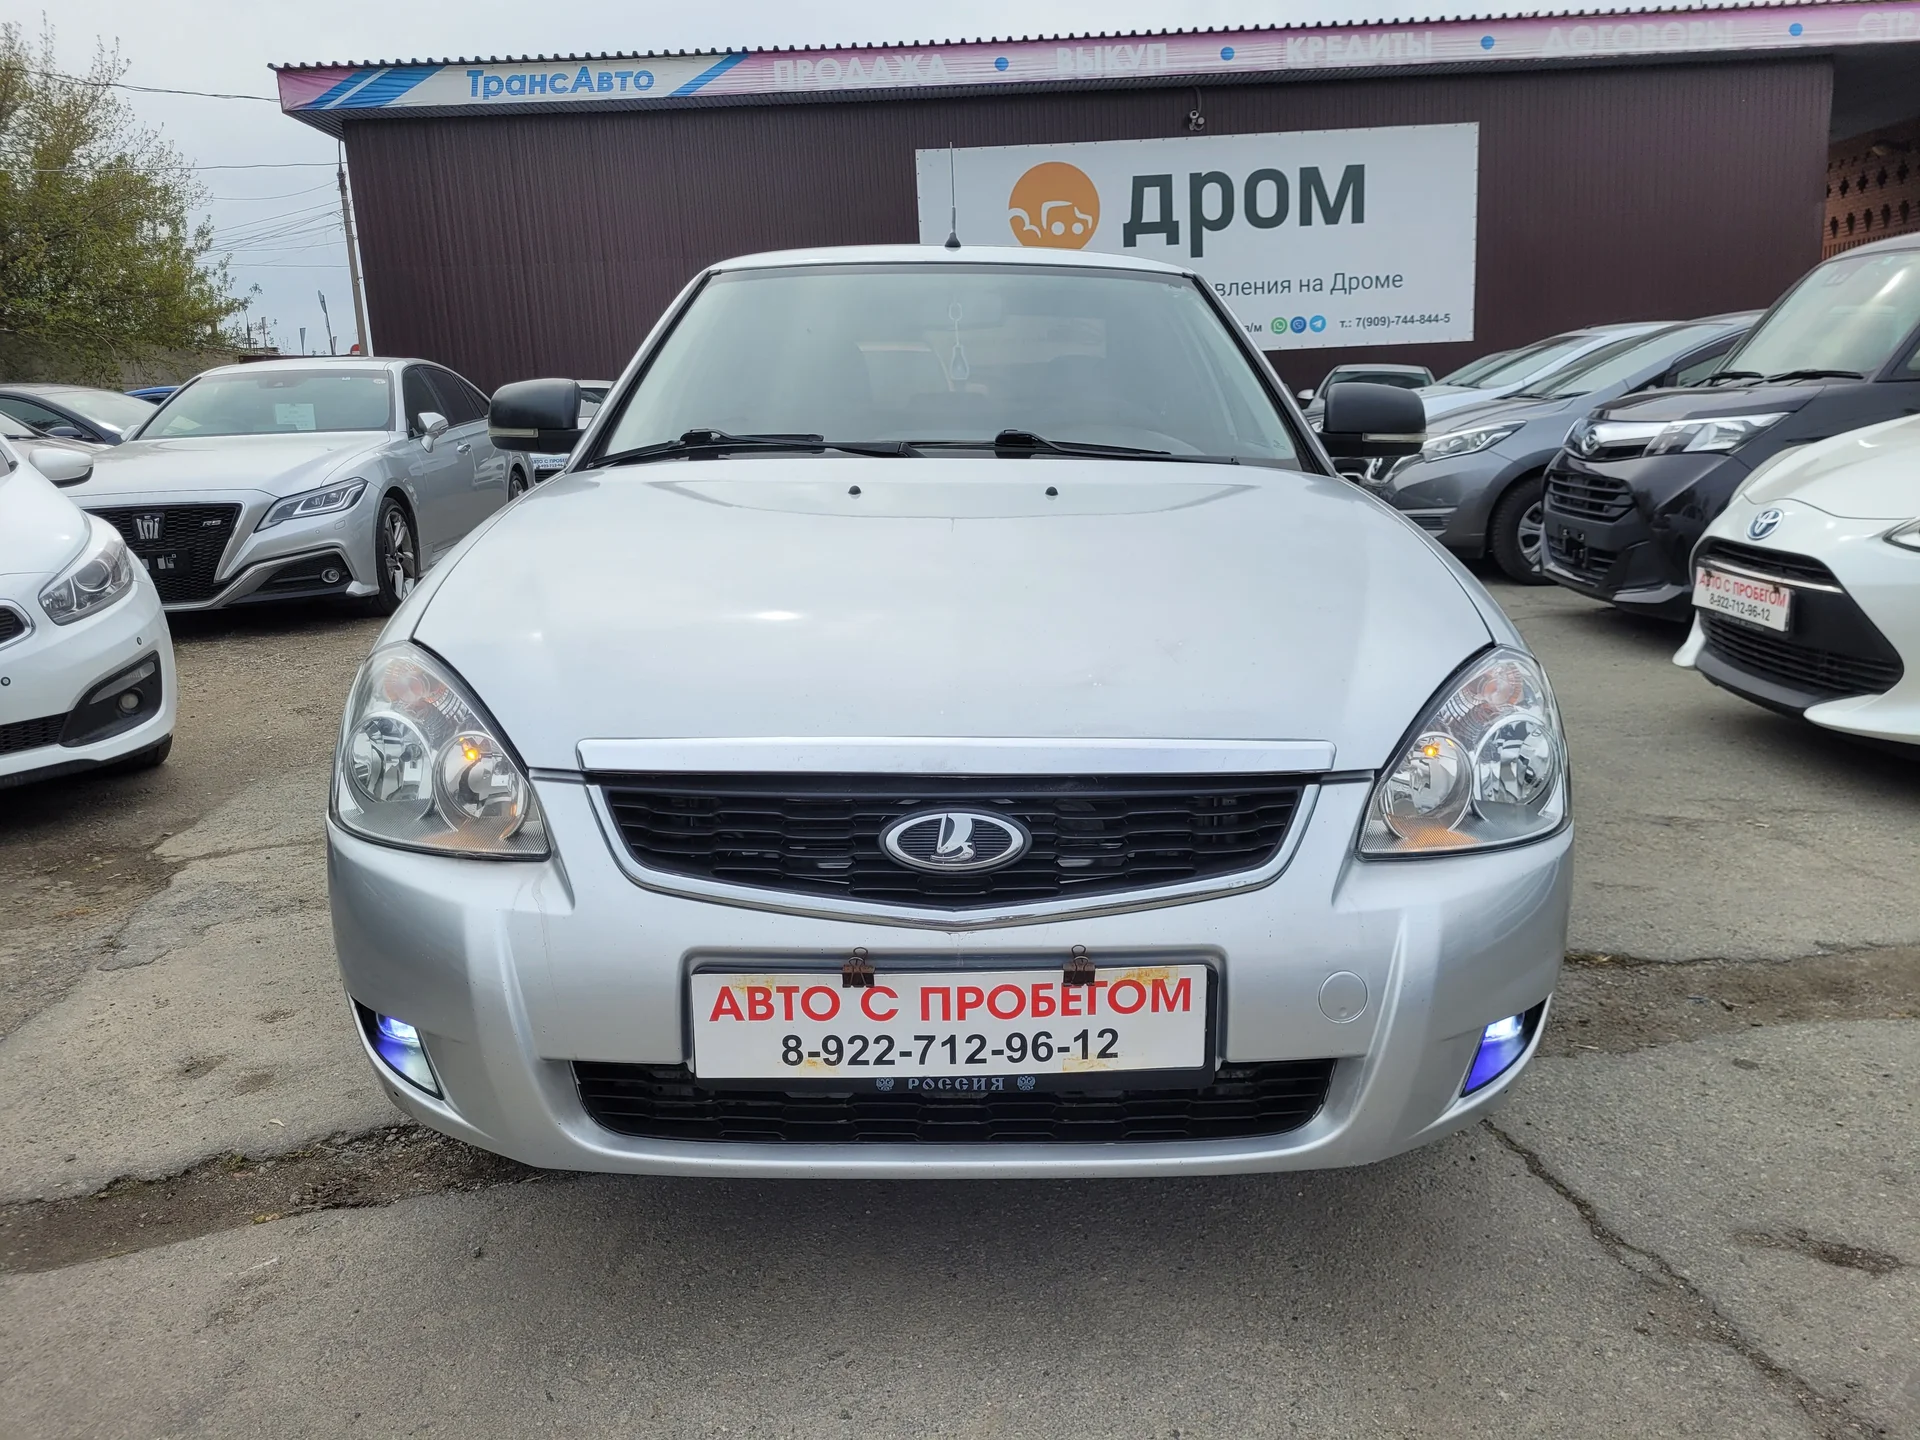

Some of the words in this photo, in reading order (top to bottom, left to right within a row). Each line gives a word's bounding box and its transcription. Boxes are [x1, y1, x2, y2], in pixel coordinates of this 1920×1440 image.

[1858, 11, 1920, 38] СТР
[1056, 43, 1167, 75] ВЫКУП
[1286, 31, 1433, 62] КРЕДИТЫ
[466, 66, 655, 100] ТрансАвто
[773, 54, 949, 88] ПРОДАЖА
[1300, 277, 1323, 293] на
[1330, 272, 1404, 295] Дроме
[1355, 313, 1451, 329] 7(909)-744-844-5
[202, 519, 222, 527] RS
[1709, 593, 1771, 622] 8-922-712-96-12
[1723, 579, 1731, 592] С
[1733, 582, 1786, 607] ПРОБЕГОМ
[709, 985, 841, 1022] АВТО
[860, 985, 899, 1022] С
[920, 977, 1192, 1022] ПРОБЕГОМ
[781, 1027, 1119, 1067] 8-922-712-96-12
[908, 1077, 1004, 1091] РОССИЯ
